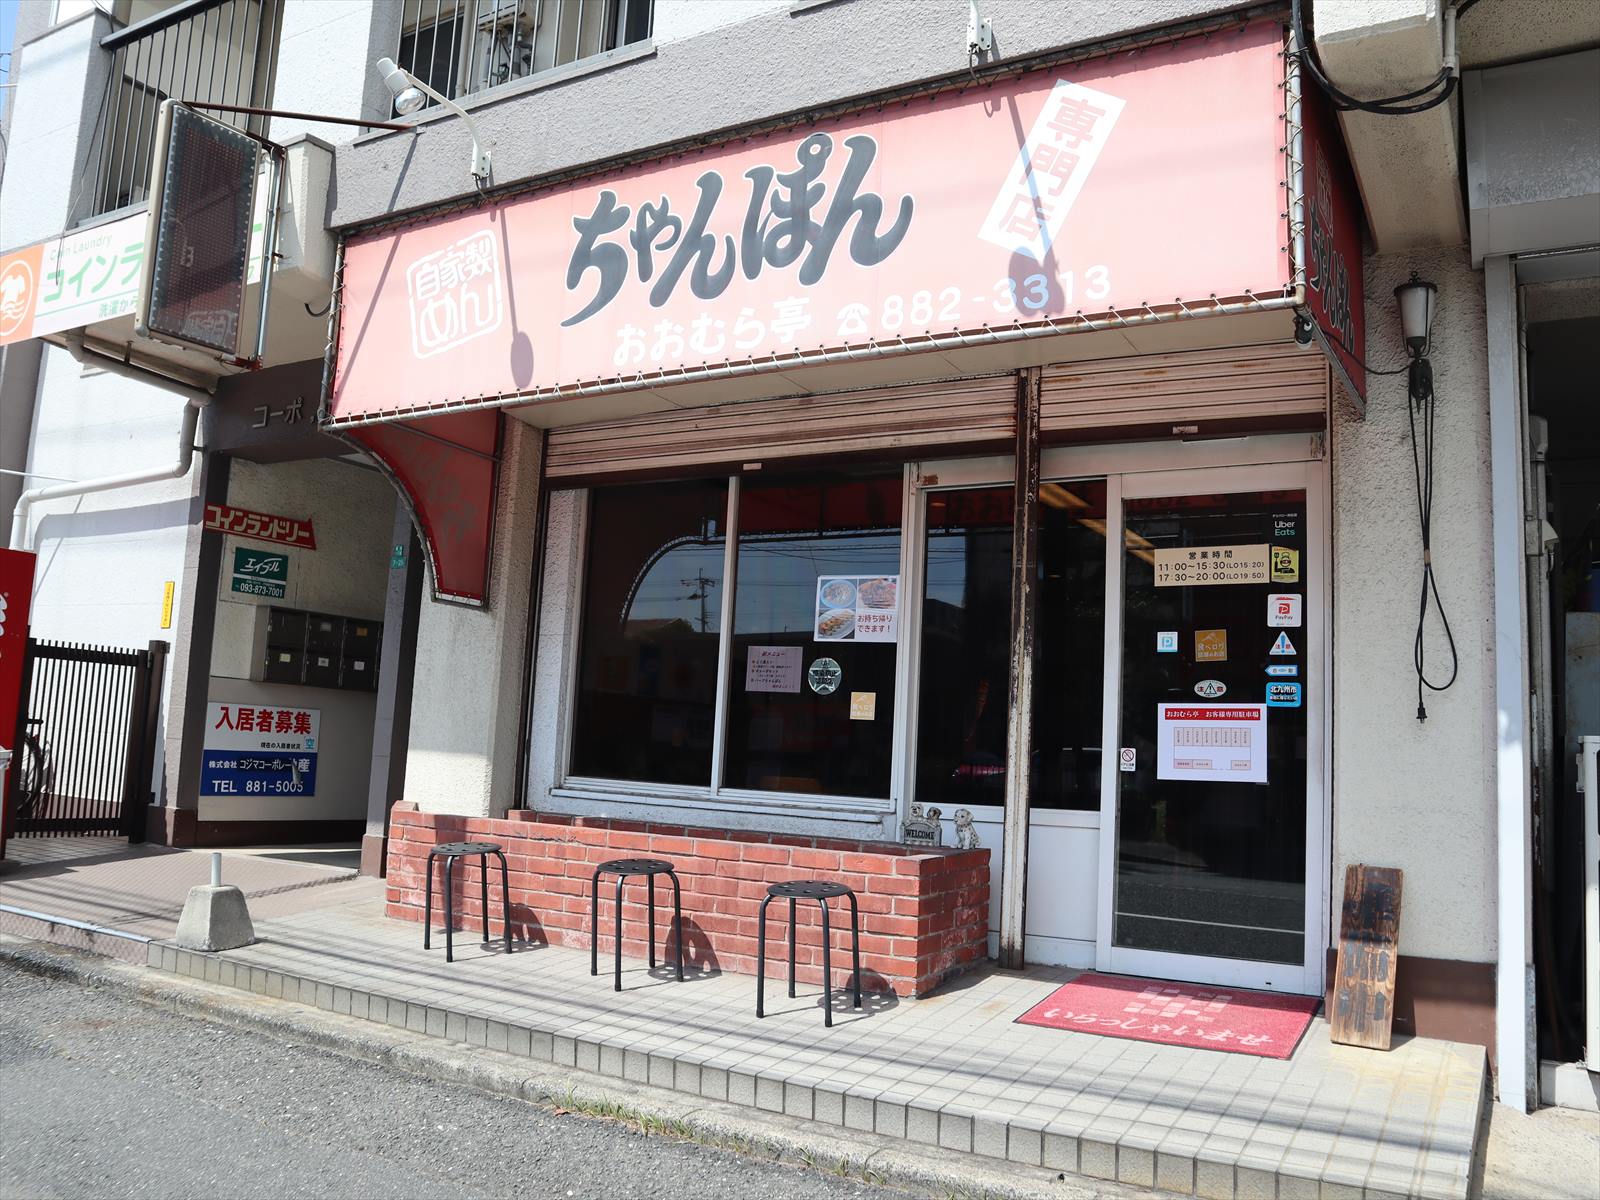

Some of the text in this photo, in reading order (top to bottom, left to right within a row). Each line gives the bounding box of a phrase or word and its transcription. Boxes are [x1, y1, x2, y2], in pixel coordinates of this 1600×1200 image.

[561, 132, 913, 327] ちゃんぽん
[416, 237, 493, 302] 自家製
[420, 282, 495, 347] めん
[613, 265, 1110, 367] おおむら亭 882-3313
[205, 505, 310, 542] コインランドリー
[1188, 550, 1233, 560] 営業時間
[240, 557, 282, 575] エイブル
[240, 582, 283, 597] 093-873-7001
[857, 614, 893, 623] お持ち帰り
[215, 706, 312, 735] 入居者募集
[1167, 710, 1259, 718] おおむら亭 お客様専用駐車場
[260, 742, 301, 750] 現在の入居者状況
[208, 760, 237, 769] 株式会社
[212, 780, 238, 793] TEL
[905, 829, 935, 840] WELCOME
[1043, 1008, 1274, 1047] いらっしゃいませ
